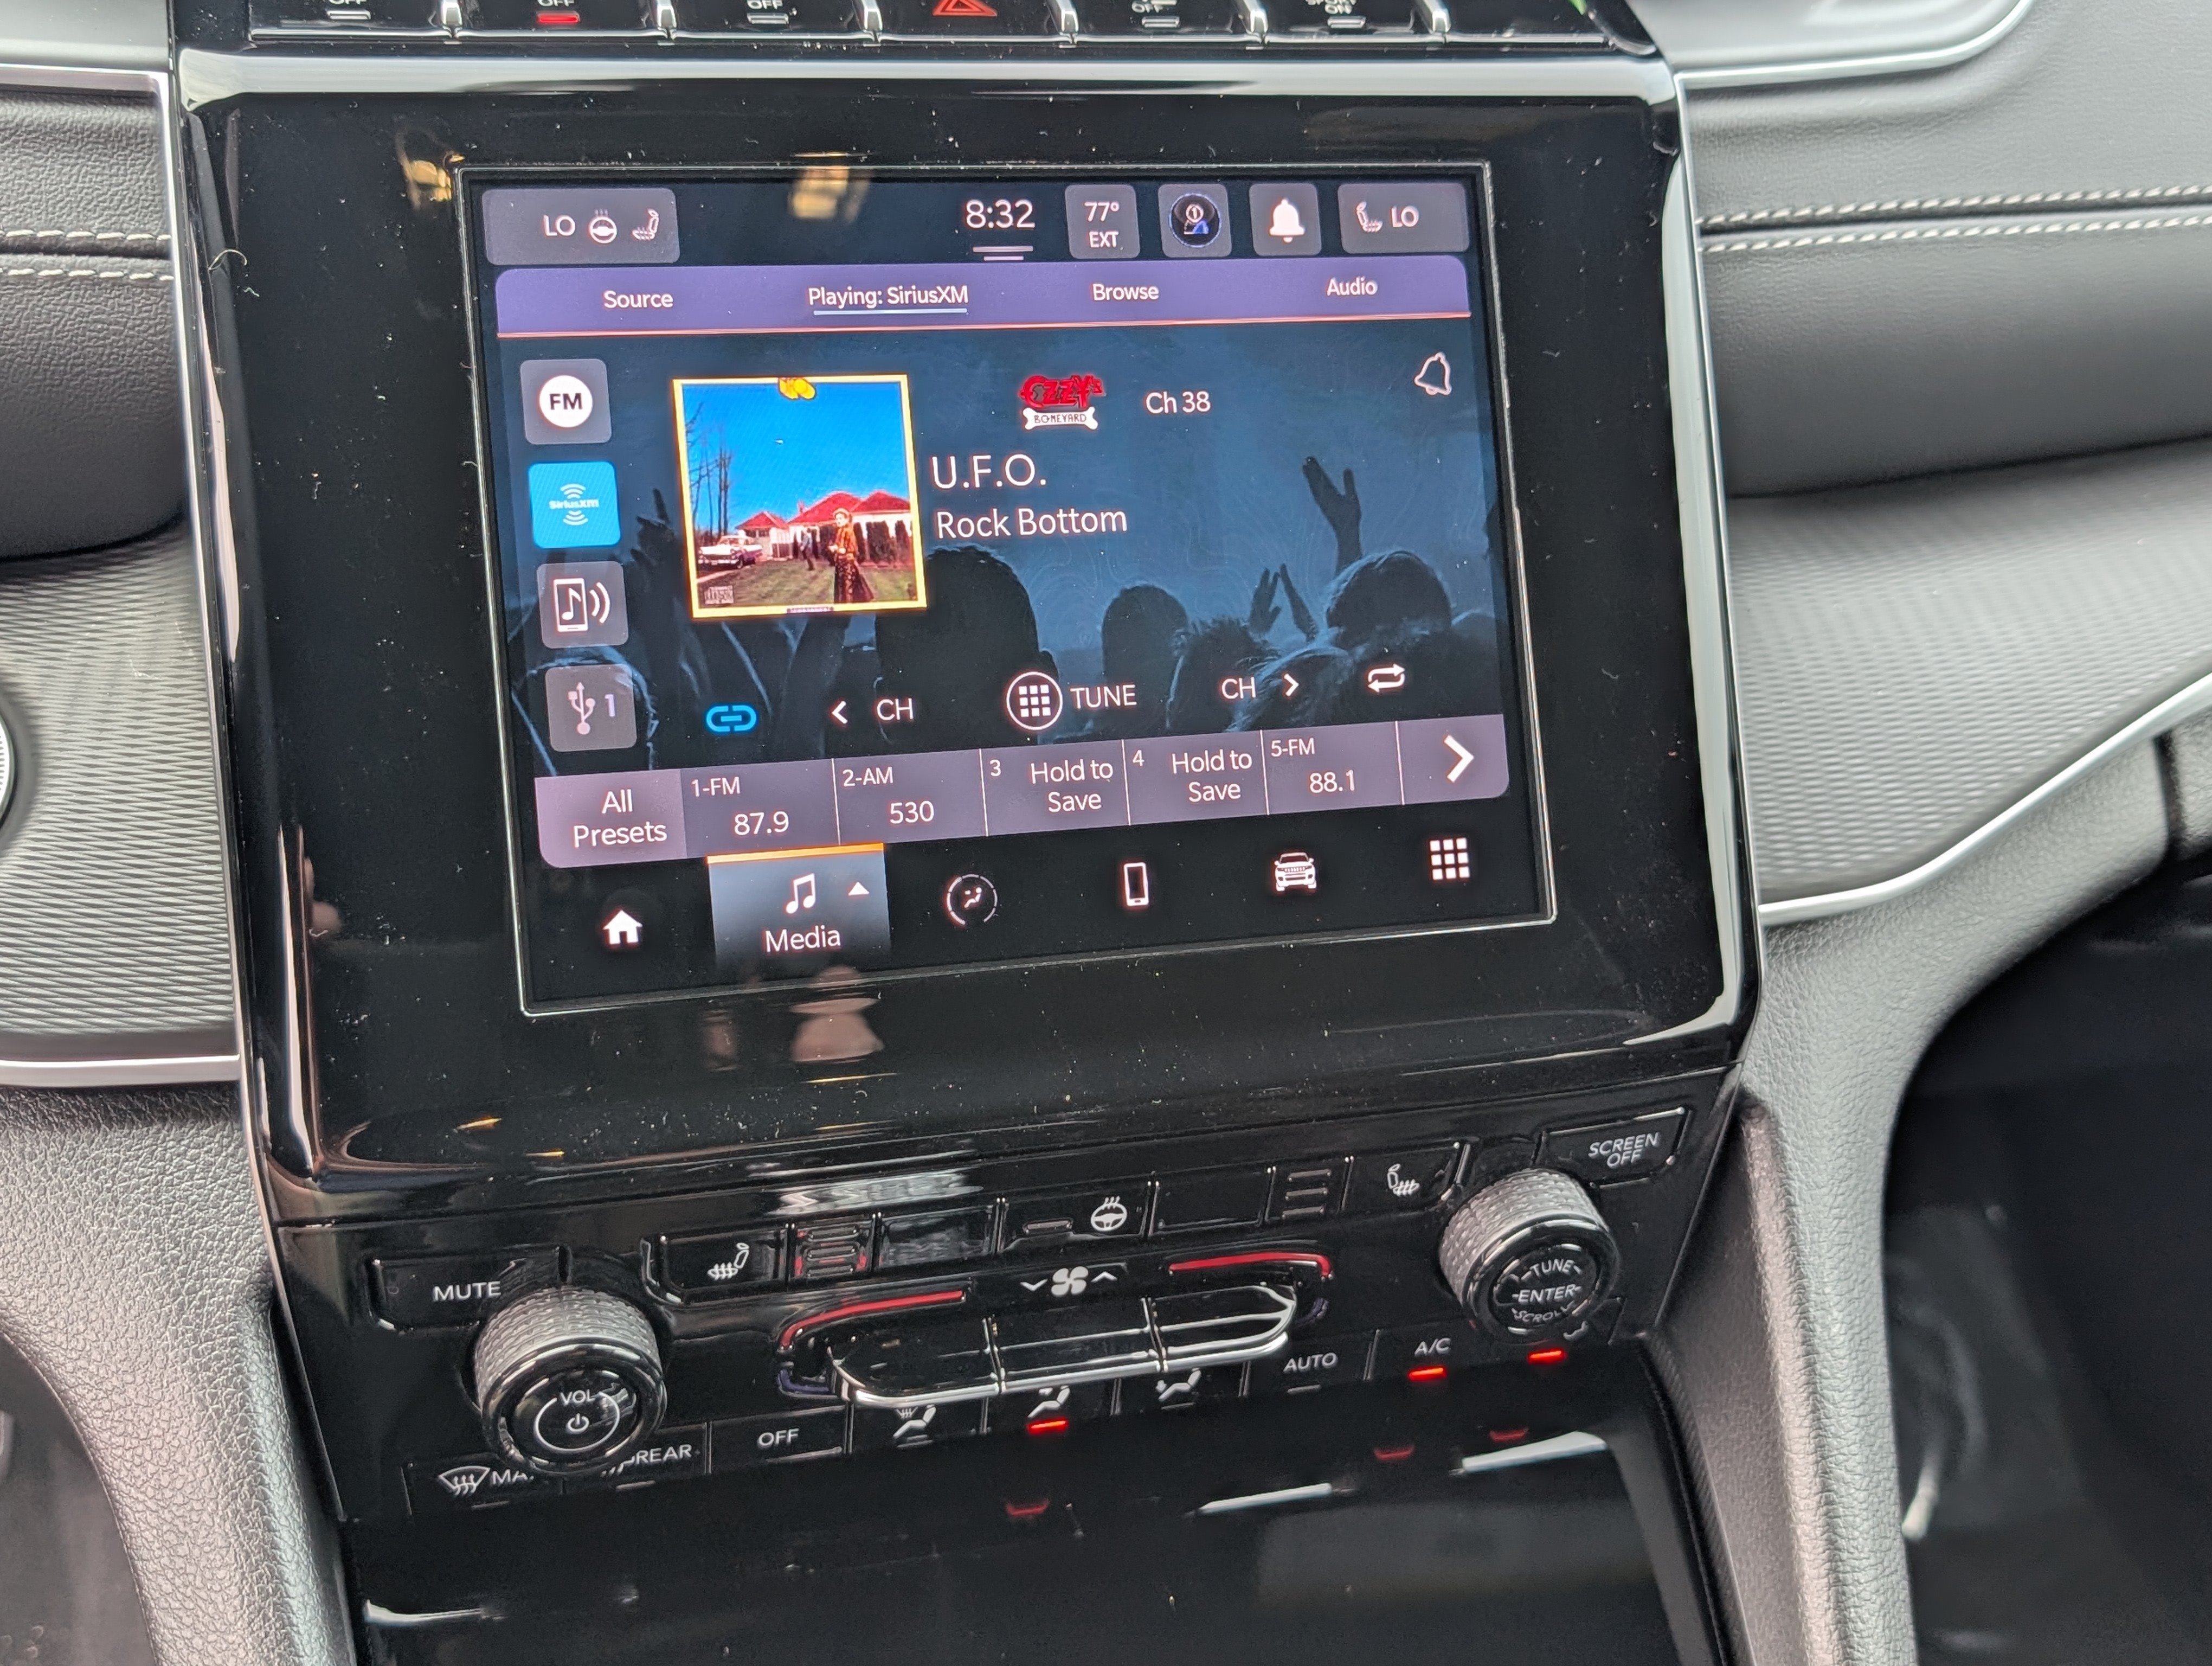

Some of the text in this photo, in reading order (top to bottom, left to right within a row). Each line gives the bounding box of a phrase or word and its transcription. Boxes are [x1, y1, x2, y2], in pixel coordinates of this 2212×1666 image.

[1324, 3, 1353, 14] ON
[964, 198, 1036, 230] 8:32
[1391, 206, 1419, 228] LO
[544, 213, 575, 237] LO
[1089, 230, 1119, 248] EXT
[808, 285, 969, 309] Playing: SiriusXM
[1092, 283, 1160, 302] Browse
[1327, 277, 1378, 297] Audio
[603, 289, 674, 310] Source
[549, 393, 583, 410] FM
[1146, 391, 1211, 414] Ch 38
[1034, 414, 1086, 424] BONEYARD
[931, 454, 1046, 489] U.F.O.
[937, 508, 1128, 539] Rock Bottom
[1070, 685, 1137, 709] TUNE
[1221, 676, 1256, 700] CH
[605, 694, 615, 717] 1
[877, 698, 914, 721] CH
[1270, 738, 1316, 757] 5-FM
[990, 760, 1001, 777] 3
[1132, 750, 1145, 767] 4
[1171, 749, 1253, 774] Hold to
[843, 767, 894, 787] 2-AM
[1031, 759, 1114, 785] Hold to
[1309, 770, 1356, 793] 88.1
[691, 777, 741, 797] 1-FM
[1188, 781, 1241, 803] Save
[602, 790, 633, 813] All
[1048, 792, 1102, 813] Save
[889, 801, 935, 824] 530
[734, 811, 789, 836] 87.9
[574, 822, 667, 848] Presets
[765, 926, 841, 953] Media
[1588, 1132, 1660, 1159] SCREEN
[1606, 1149, 1643, 1169] OFF
[1529, 1259, 1575, 1277] TUNE
[433, 1281, 501, 1302] MUTE
[1519, 1284, 1577, 1304] ENTER
[1414, 1337, 1451, 1356] A/C
[1283, 1353, 1339, 1373] AUTO
[560, 1389, 596, 1406] VOL
[758, 1428, 799, 1449] OFF
[635, 1444, 691, 1465] REAR
[492, 1469, 535, 1485] MA
